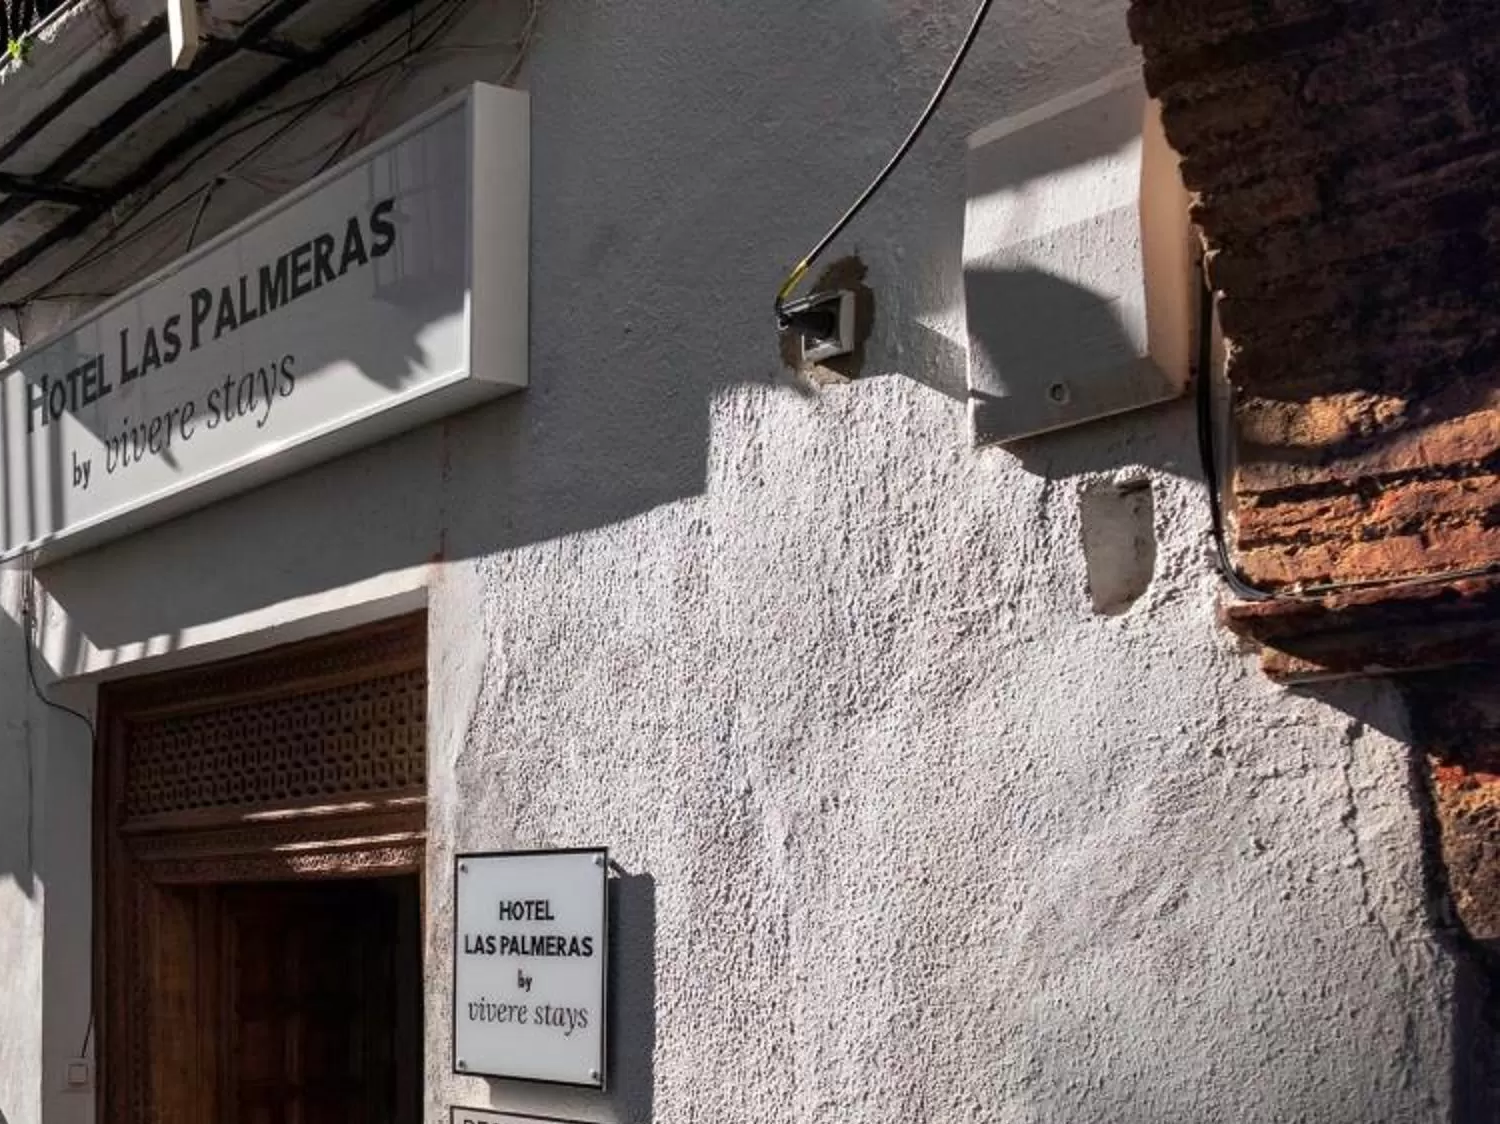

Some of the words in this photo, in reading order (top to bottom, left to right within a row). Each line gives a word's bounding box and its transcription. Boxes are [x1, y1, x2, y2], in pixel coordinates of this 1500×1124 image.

[26, 355, 112, 432] HOTEL
[119, 314, 181, 384] LAS
[190, 198, 396, 352] PALMERAS
[72, 451, 92, 488] by
[104, 408, 196, 474] vivere
[206, 354, 296, 428] stays
[499, 901, 554, 921] HOTEL
[464, 935, 496, 955] LAS
[500, 936, 593, 957] PALMERAS
[517, 969, 533, 992] by
[468, 997, 528, 1025] vivere
[533, 1003, 589, 1036] stays
